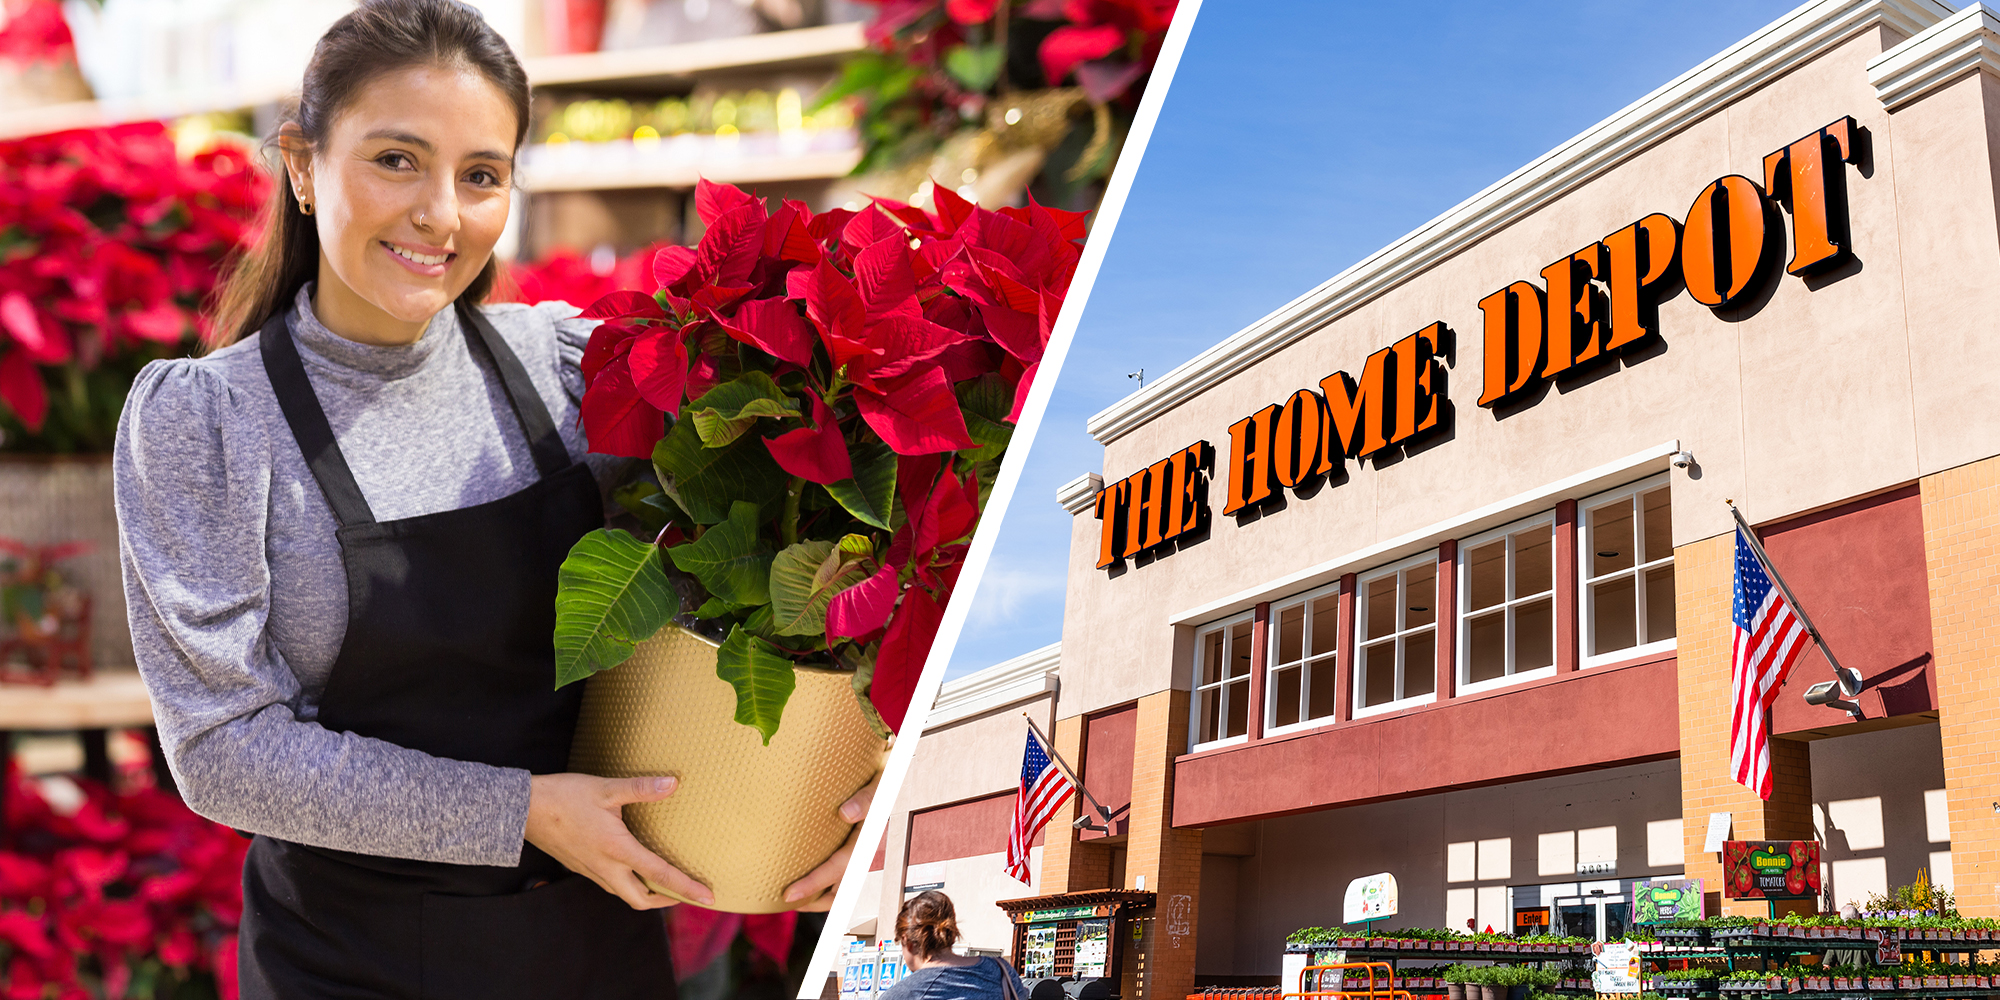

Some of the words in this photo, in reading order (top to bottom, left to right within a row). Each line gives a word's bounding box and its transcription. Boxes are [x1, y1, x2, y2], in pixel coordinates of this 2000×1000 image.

[1095, 440, 1211, 570] THE
[1223, 321, 1455, 517] HOME
[1477, 115, 1861, 409] DEPOT
[1756, 855, 1786, 867] Bonnie
[1581, 863, 1609, 875] 2001
[1759, 876, 1786, 887] TOMATOES
[1654, 891, 1677, 900] Bonnie
[1523, 913, 1543, 925] Enter
